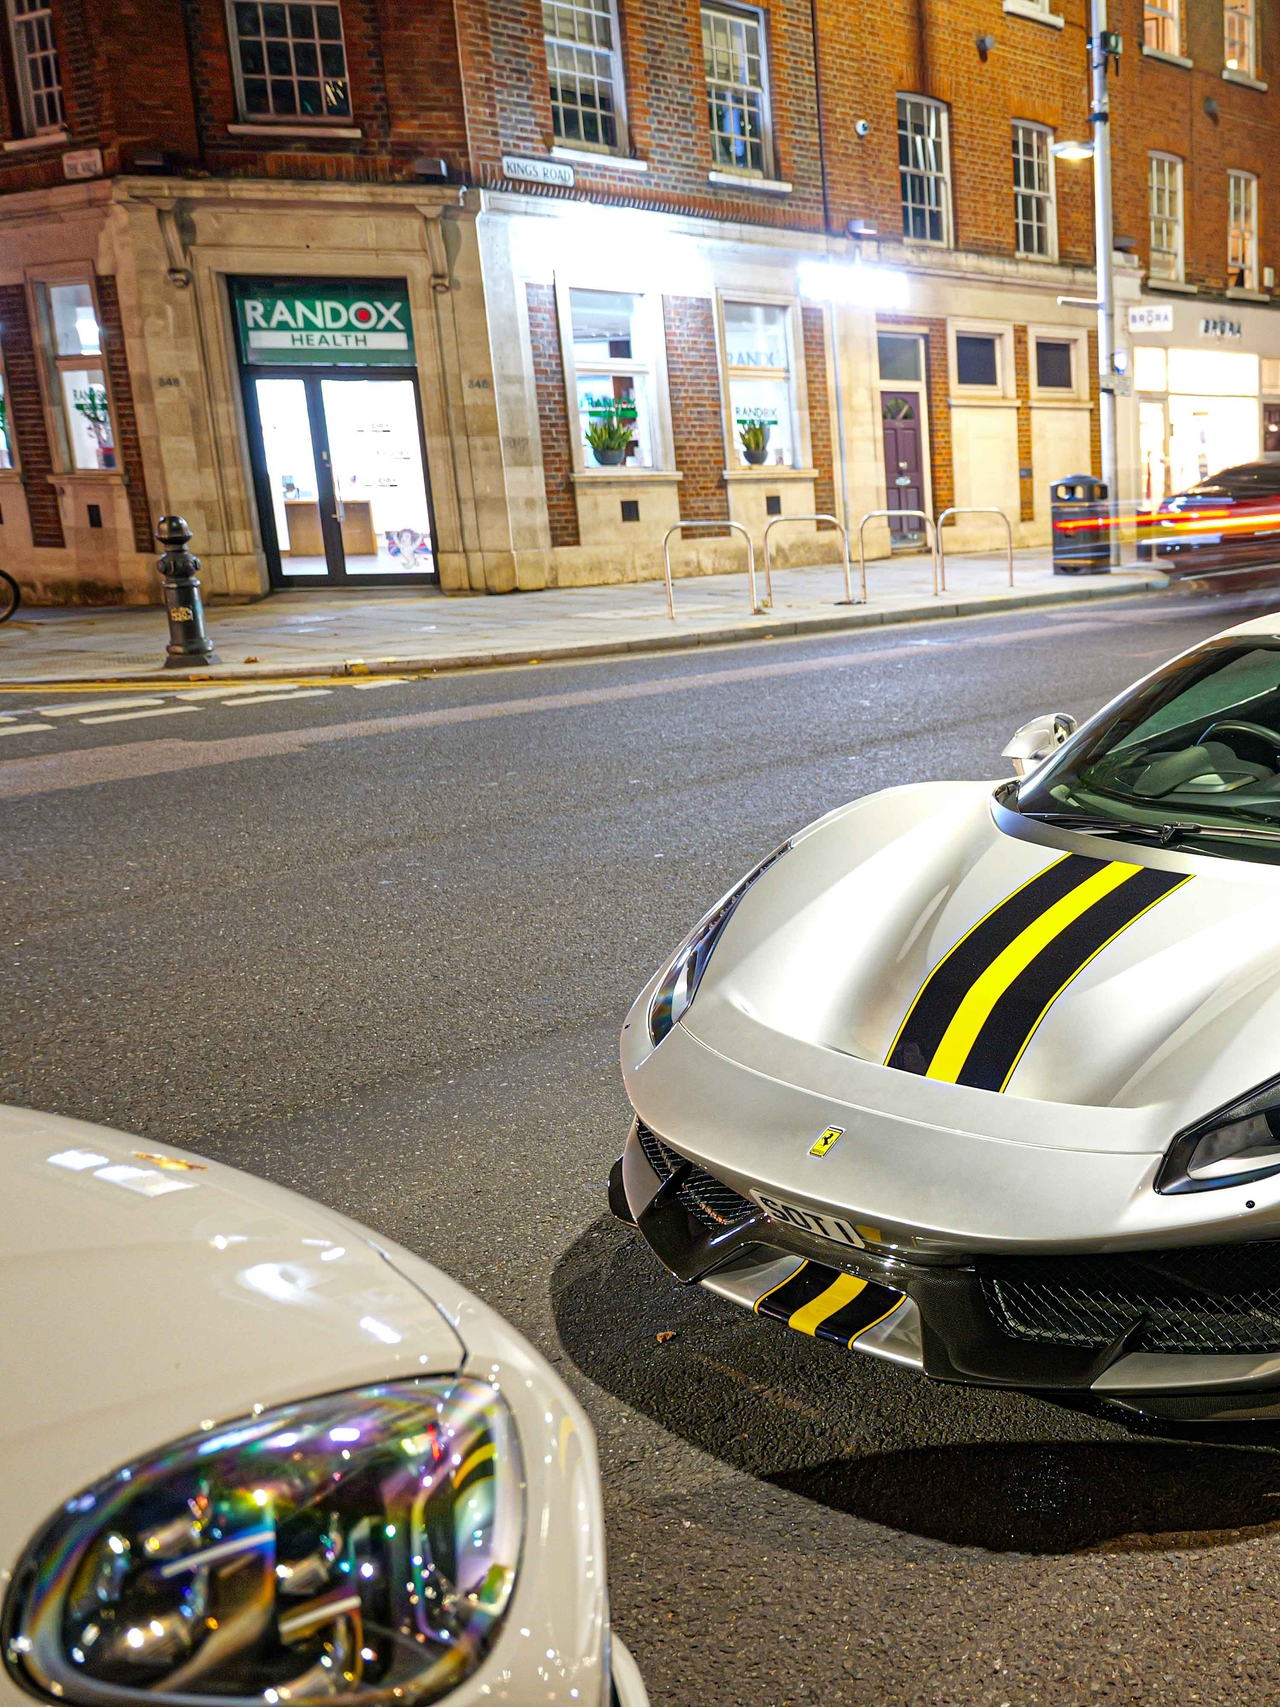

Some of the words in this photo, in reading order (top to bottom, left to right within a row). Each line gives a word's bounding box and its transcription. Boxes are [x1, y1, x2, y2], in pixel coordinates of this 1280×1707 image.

[506, 161, 539, 178] KINGS
[543, 166, 571, 183] ROAD
[244, 299, 405, 330] RANDOX
[291, 333, 368, 347] HEALTH
